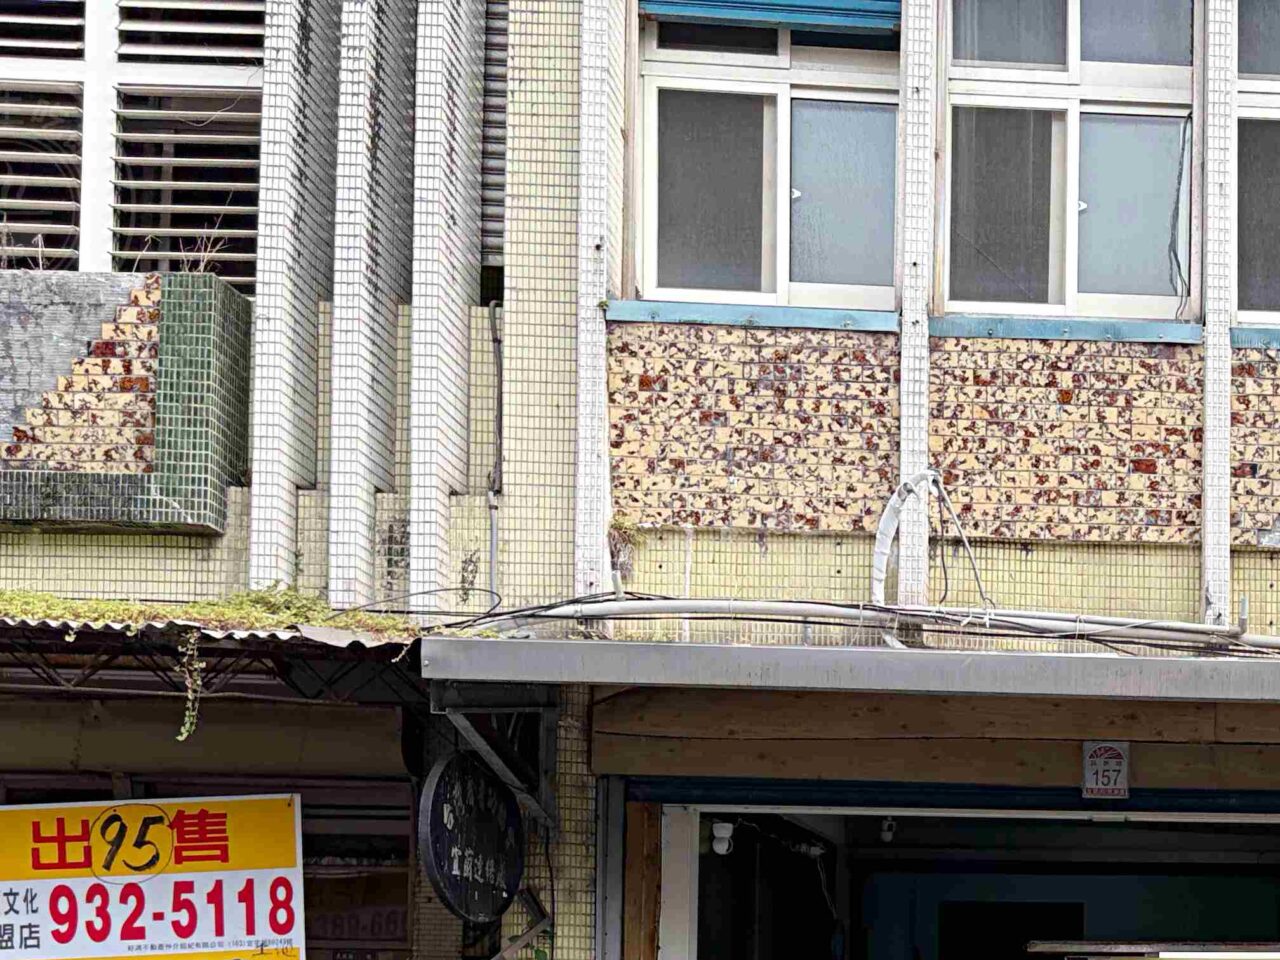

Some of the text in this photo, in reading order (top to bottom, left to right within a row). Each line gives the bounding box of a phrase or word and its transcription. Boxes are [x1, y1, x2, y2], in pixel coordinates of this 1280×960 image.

[1093, 769, 1121, 786] 157
[99, 813, 167, 872] 95
[3, 888, 39, 915] 文化
[49, 875, 296, 945] 932-5118
[0, 923, 40, 950] 盟店
